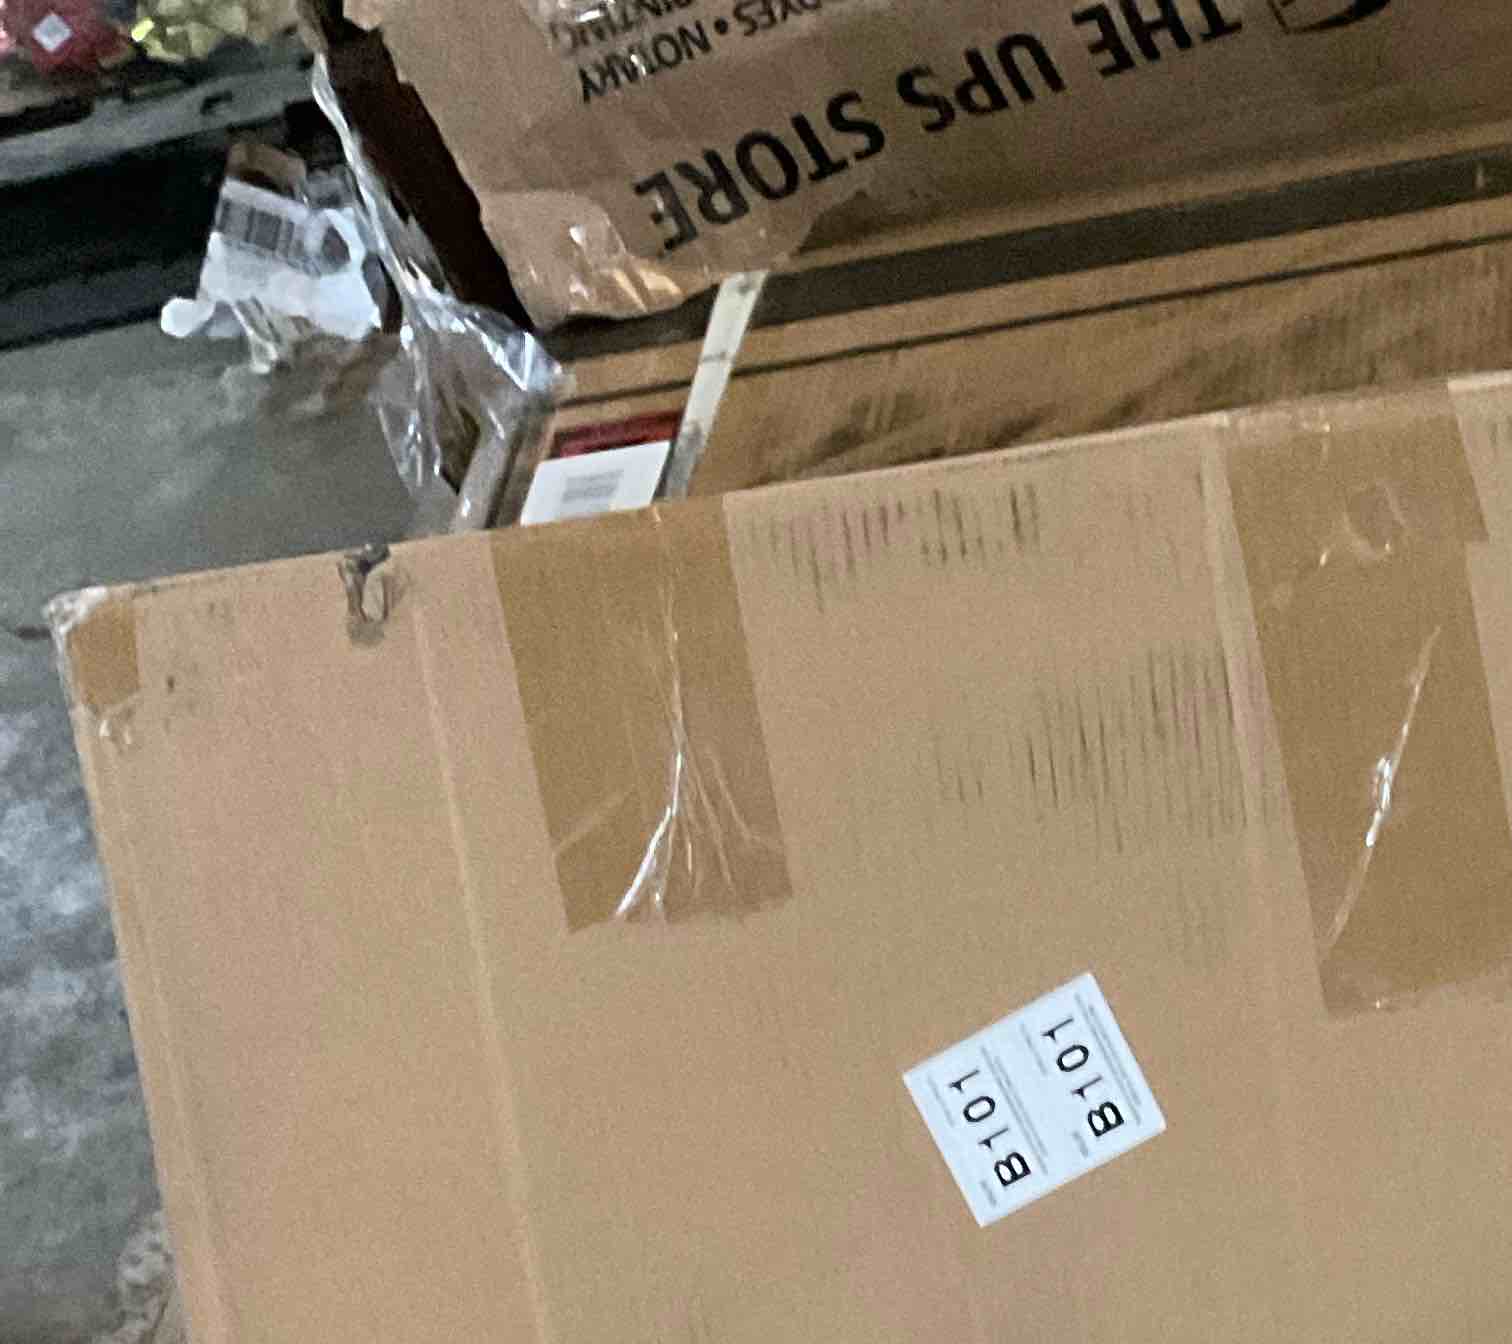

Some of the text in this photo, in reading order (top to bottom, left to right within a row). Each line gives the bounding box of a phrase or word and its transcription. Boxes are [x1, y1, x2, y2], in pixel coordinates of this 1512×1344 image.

[632, 0, 1243, 253] THE UPS STORE
[947, 1068, 1032, 1189] B101
[1039, 1016, 1126, 1138] B101
